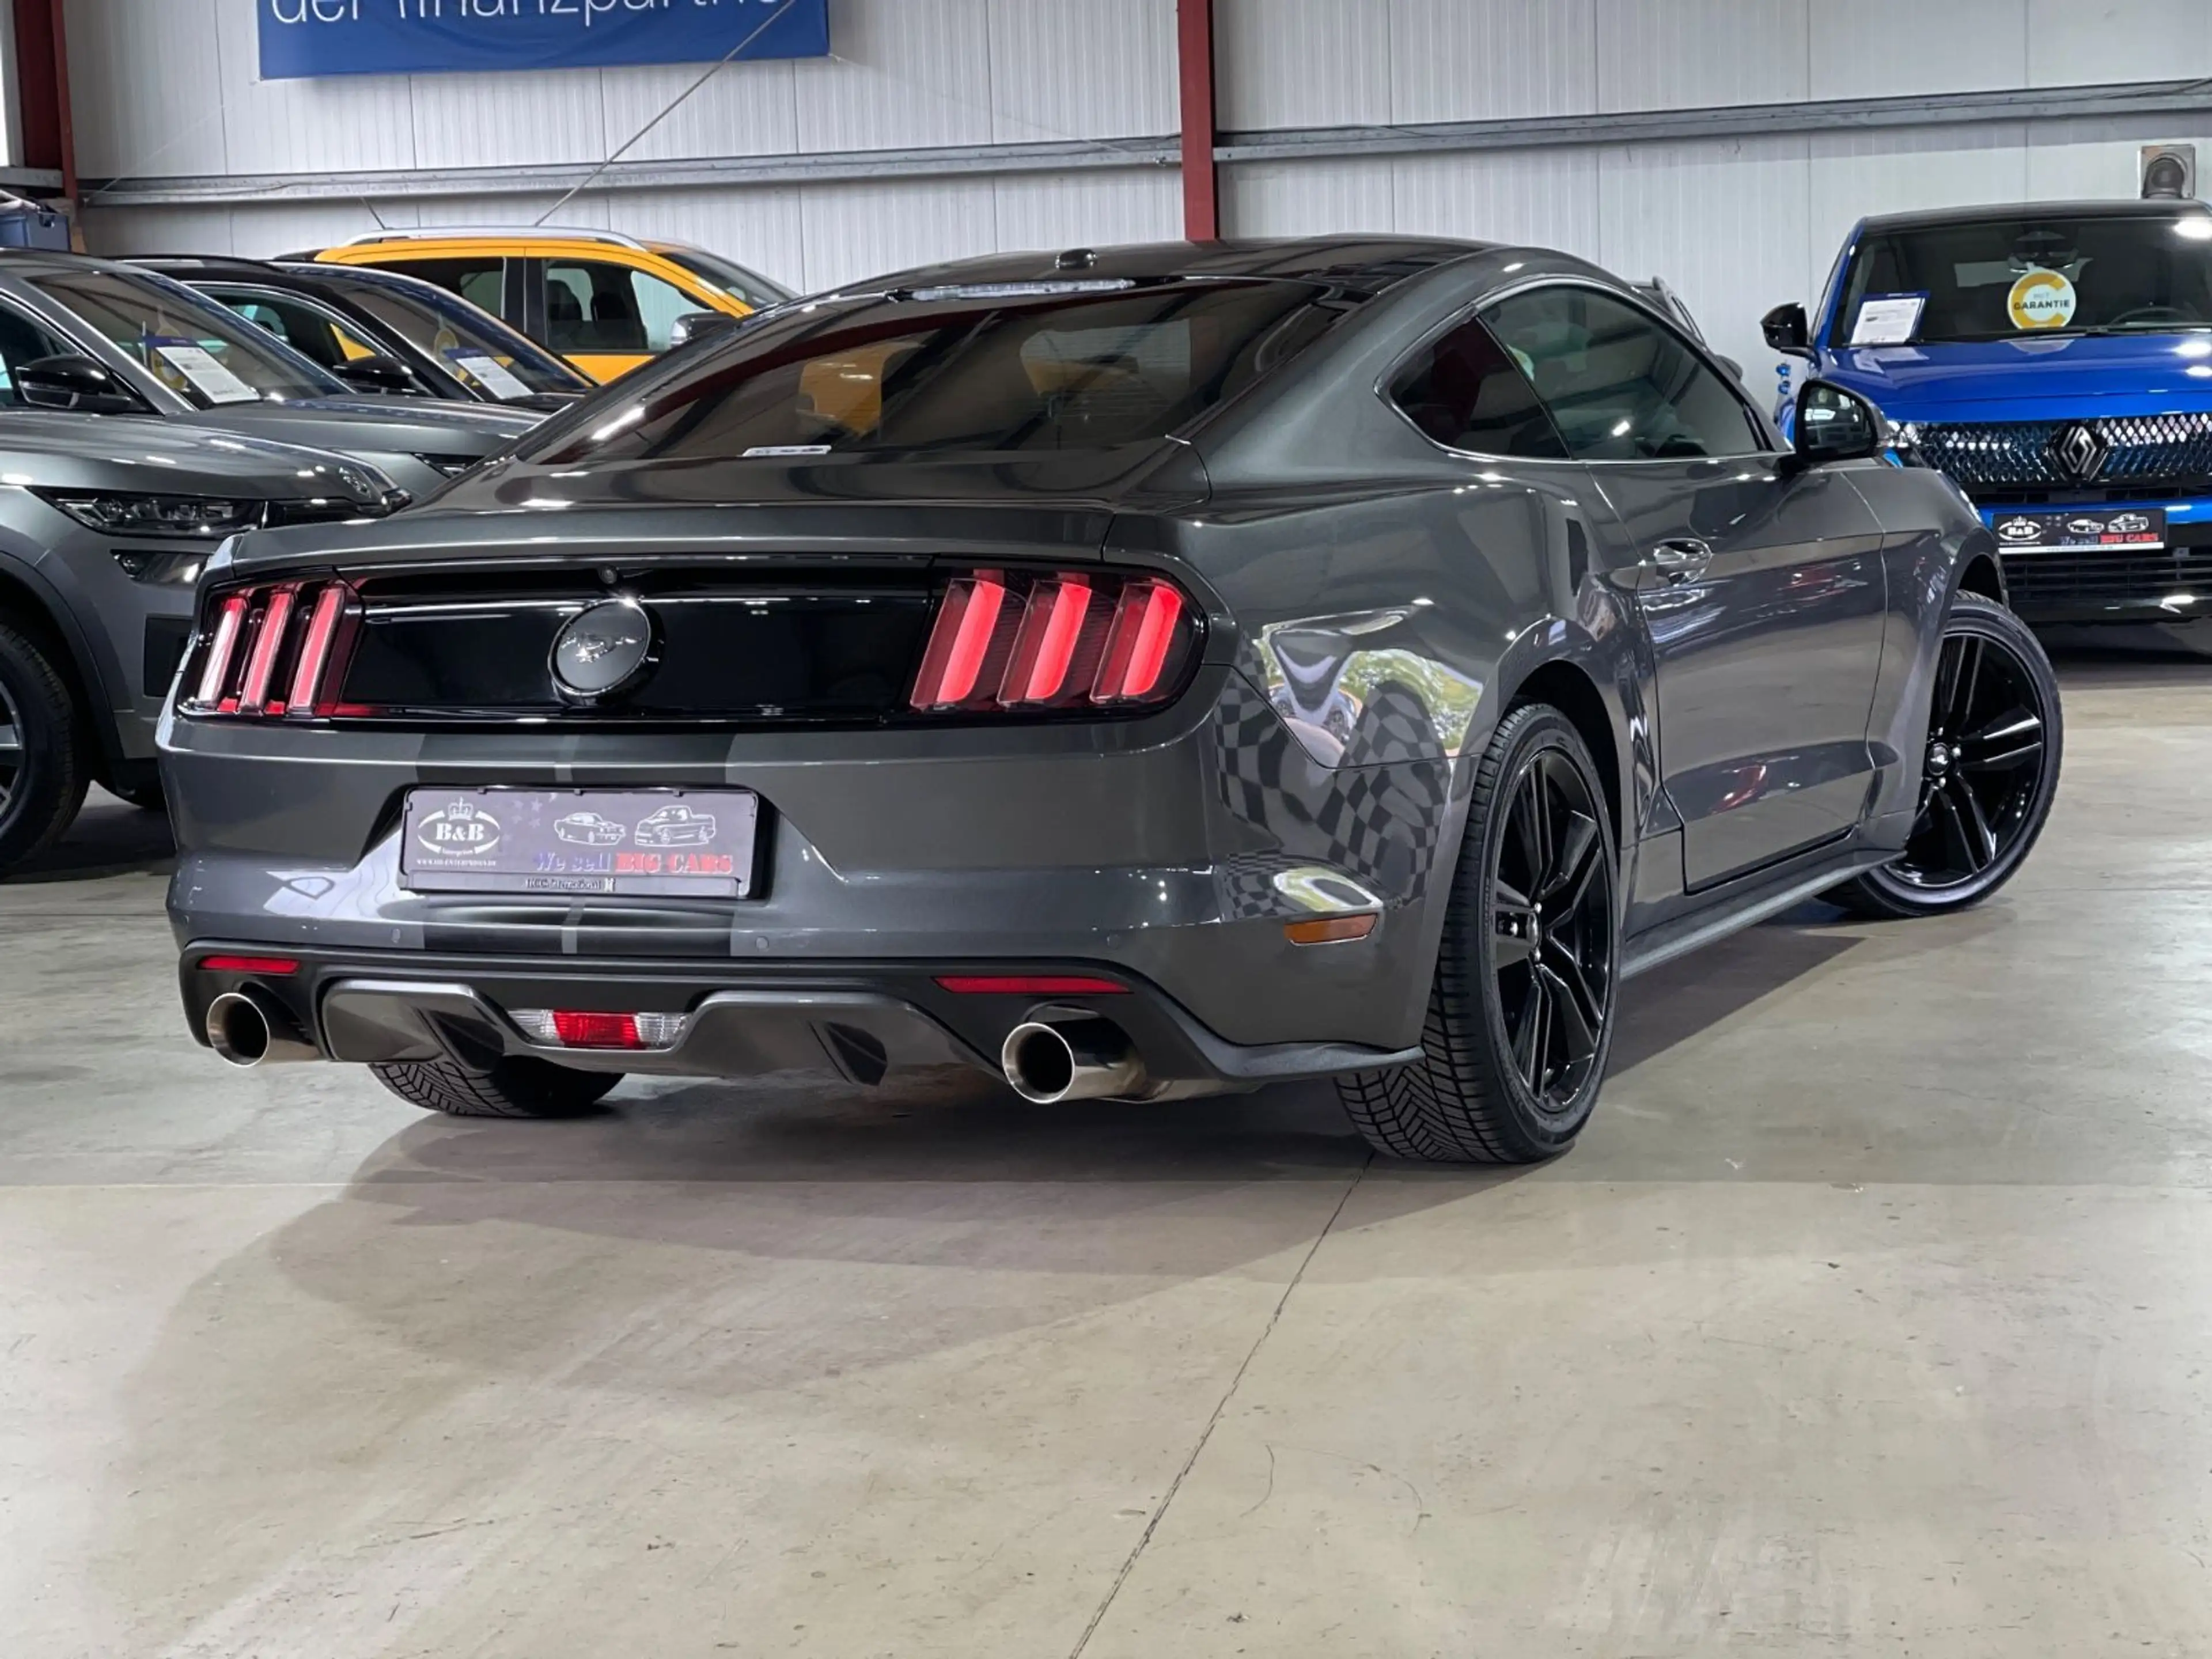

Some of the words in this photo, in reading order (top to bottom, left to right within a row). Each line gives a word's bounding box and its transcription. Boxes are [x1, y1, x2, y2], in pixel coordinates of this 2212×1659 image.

[2013, 299, 2070, 310] GARANTIE
[435, 823, 484, 841] B&B
[615, 851, 662, 874] BIG
[669, 853, 733, 874] CARS
